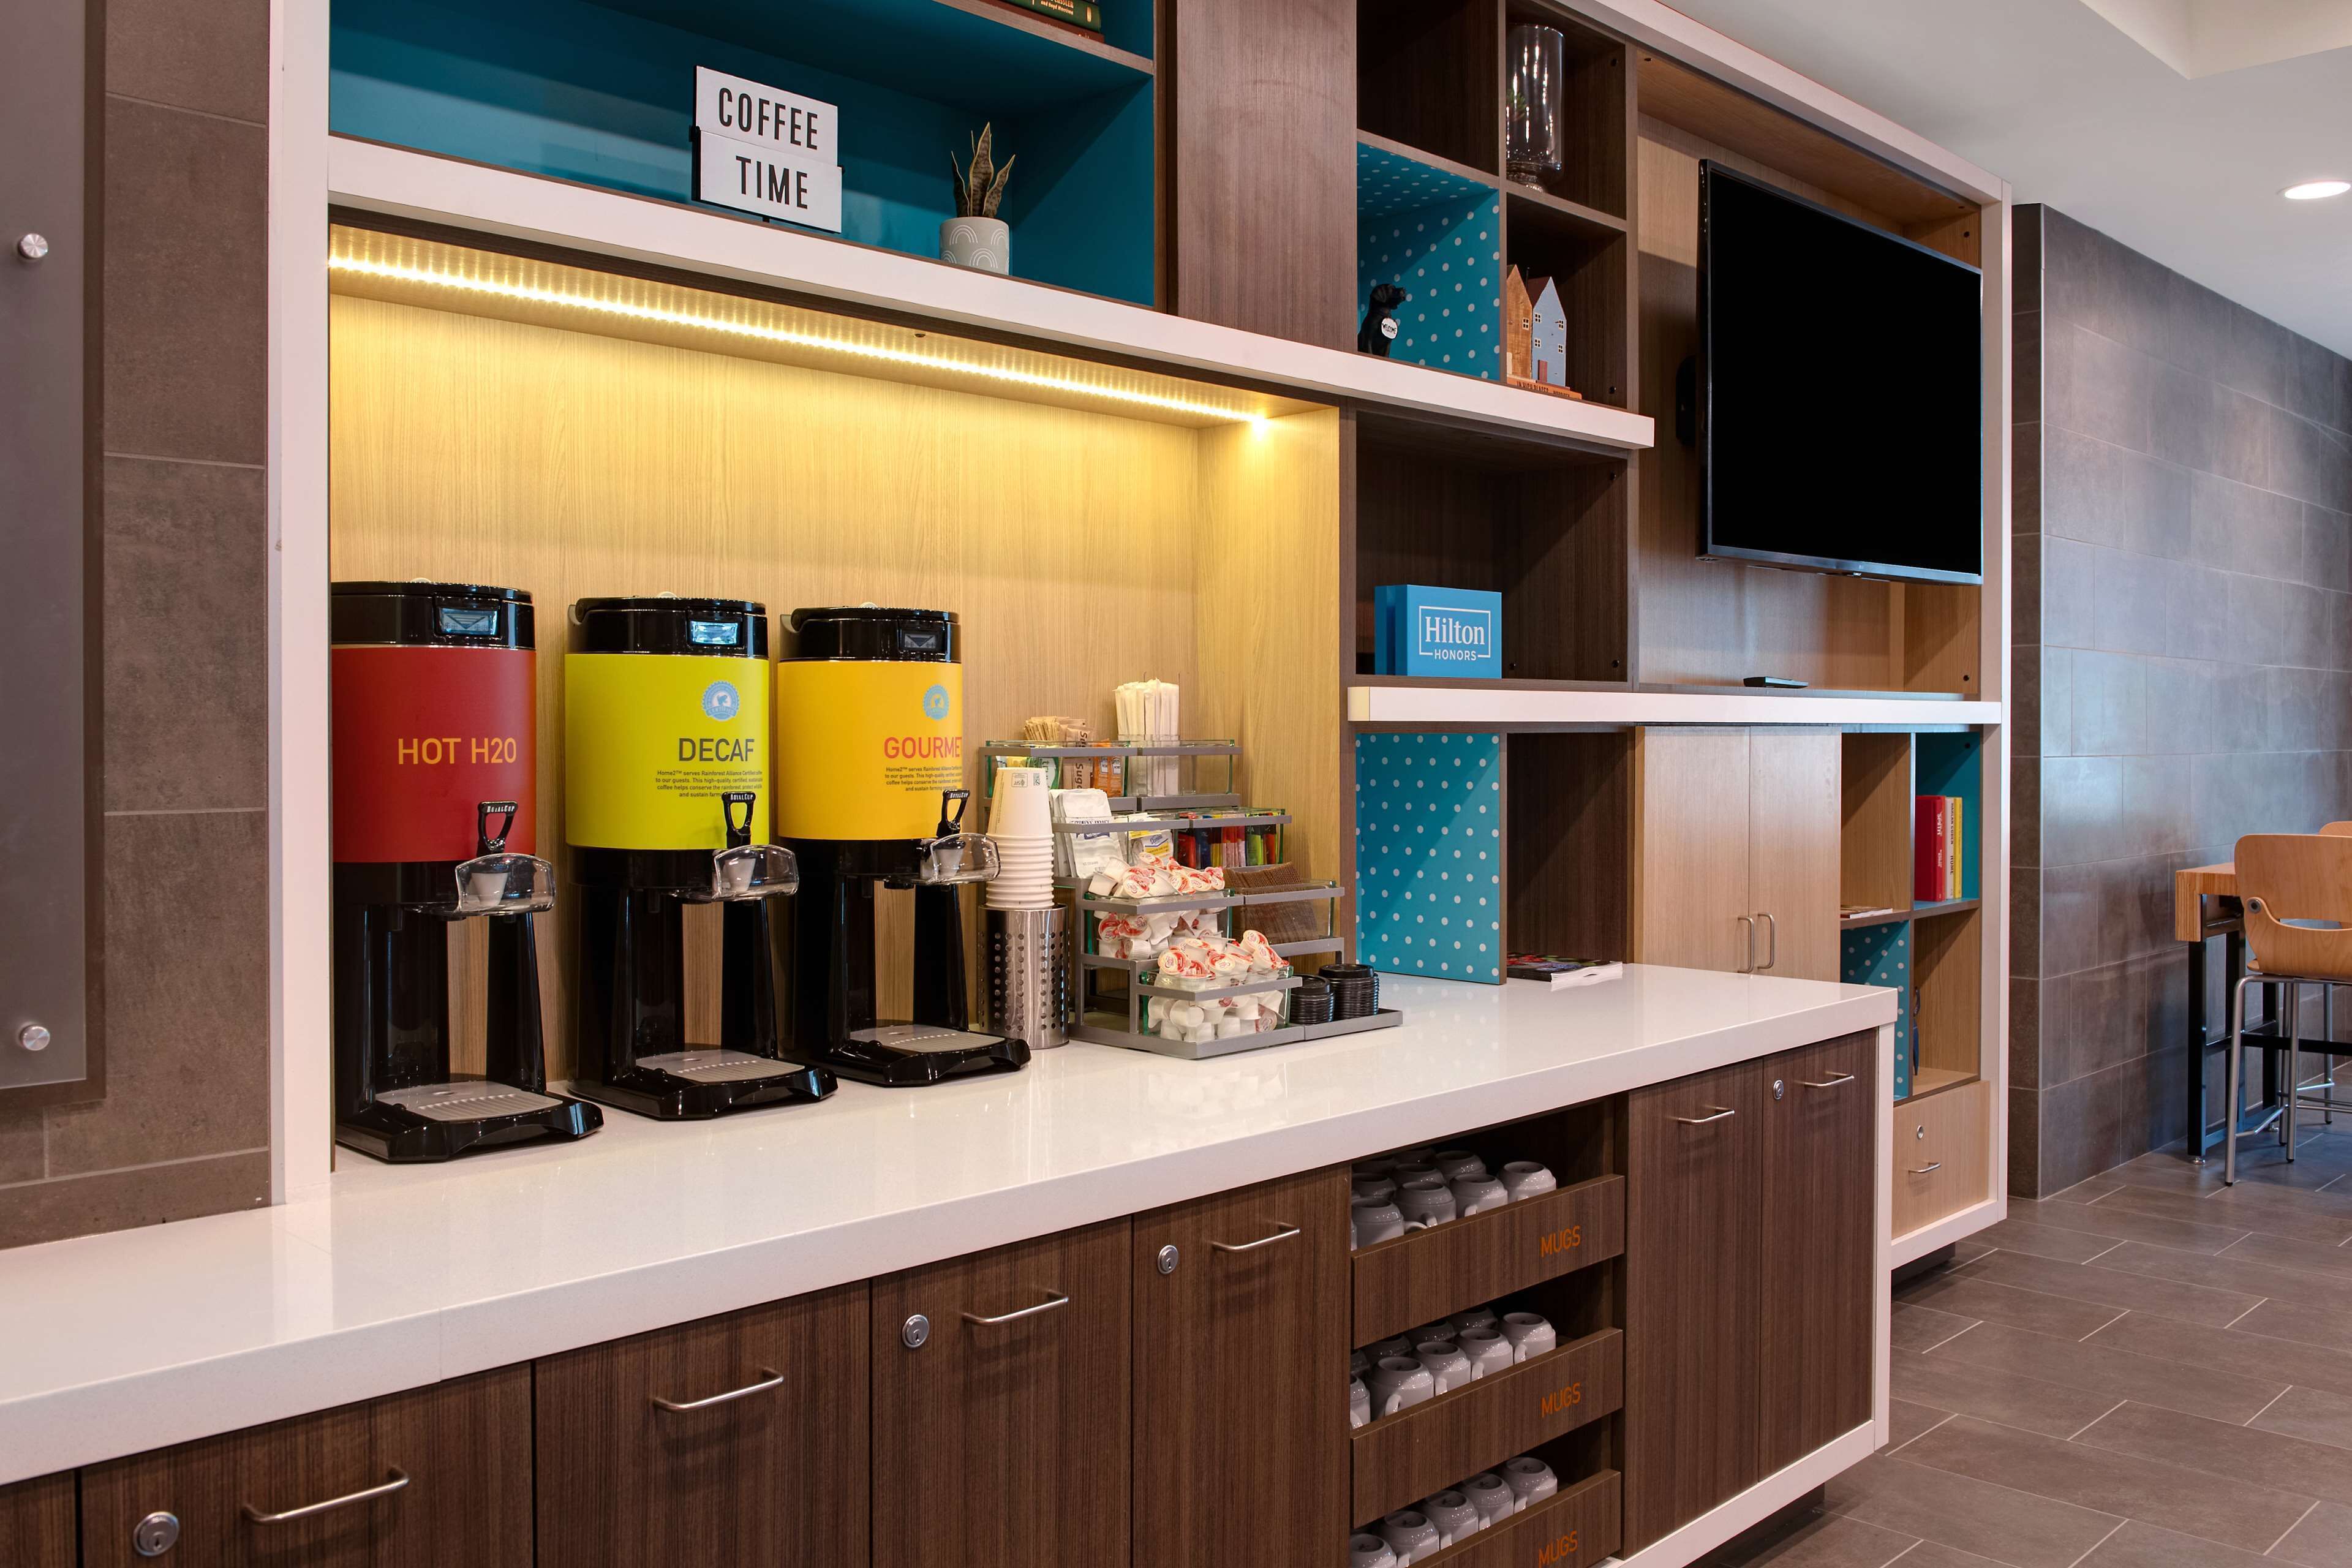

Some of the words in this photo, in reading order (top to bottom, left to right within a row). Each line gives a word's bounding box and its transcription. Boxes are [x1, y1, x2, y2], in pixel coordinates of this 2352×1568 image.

[718, 88, 818, 150] COFFEE
[736, 156, 808, 209] TIME
[1425, 616, 1485, 645] Hilton
[1434, 649, 1477, 661] HONORS
[398, 737, 461, 764] HOT
[679, 738, 755, 761] DECAF
[1540, 1225, 1580, 1258] MUGS
[1540, 1382, 1581, 1418] MUGS
[1538, 1529, 1578, 1568] MUGS
